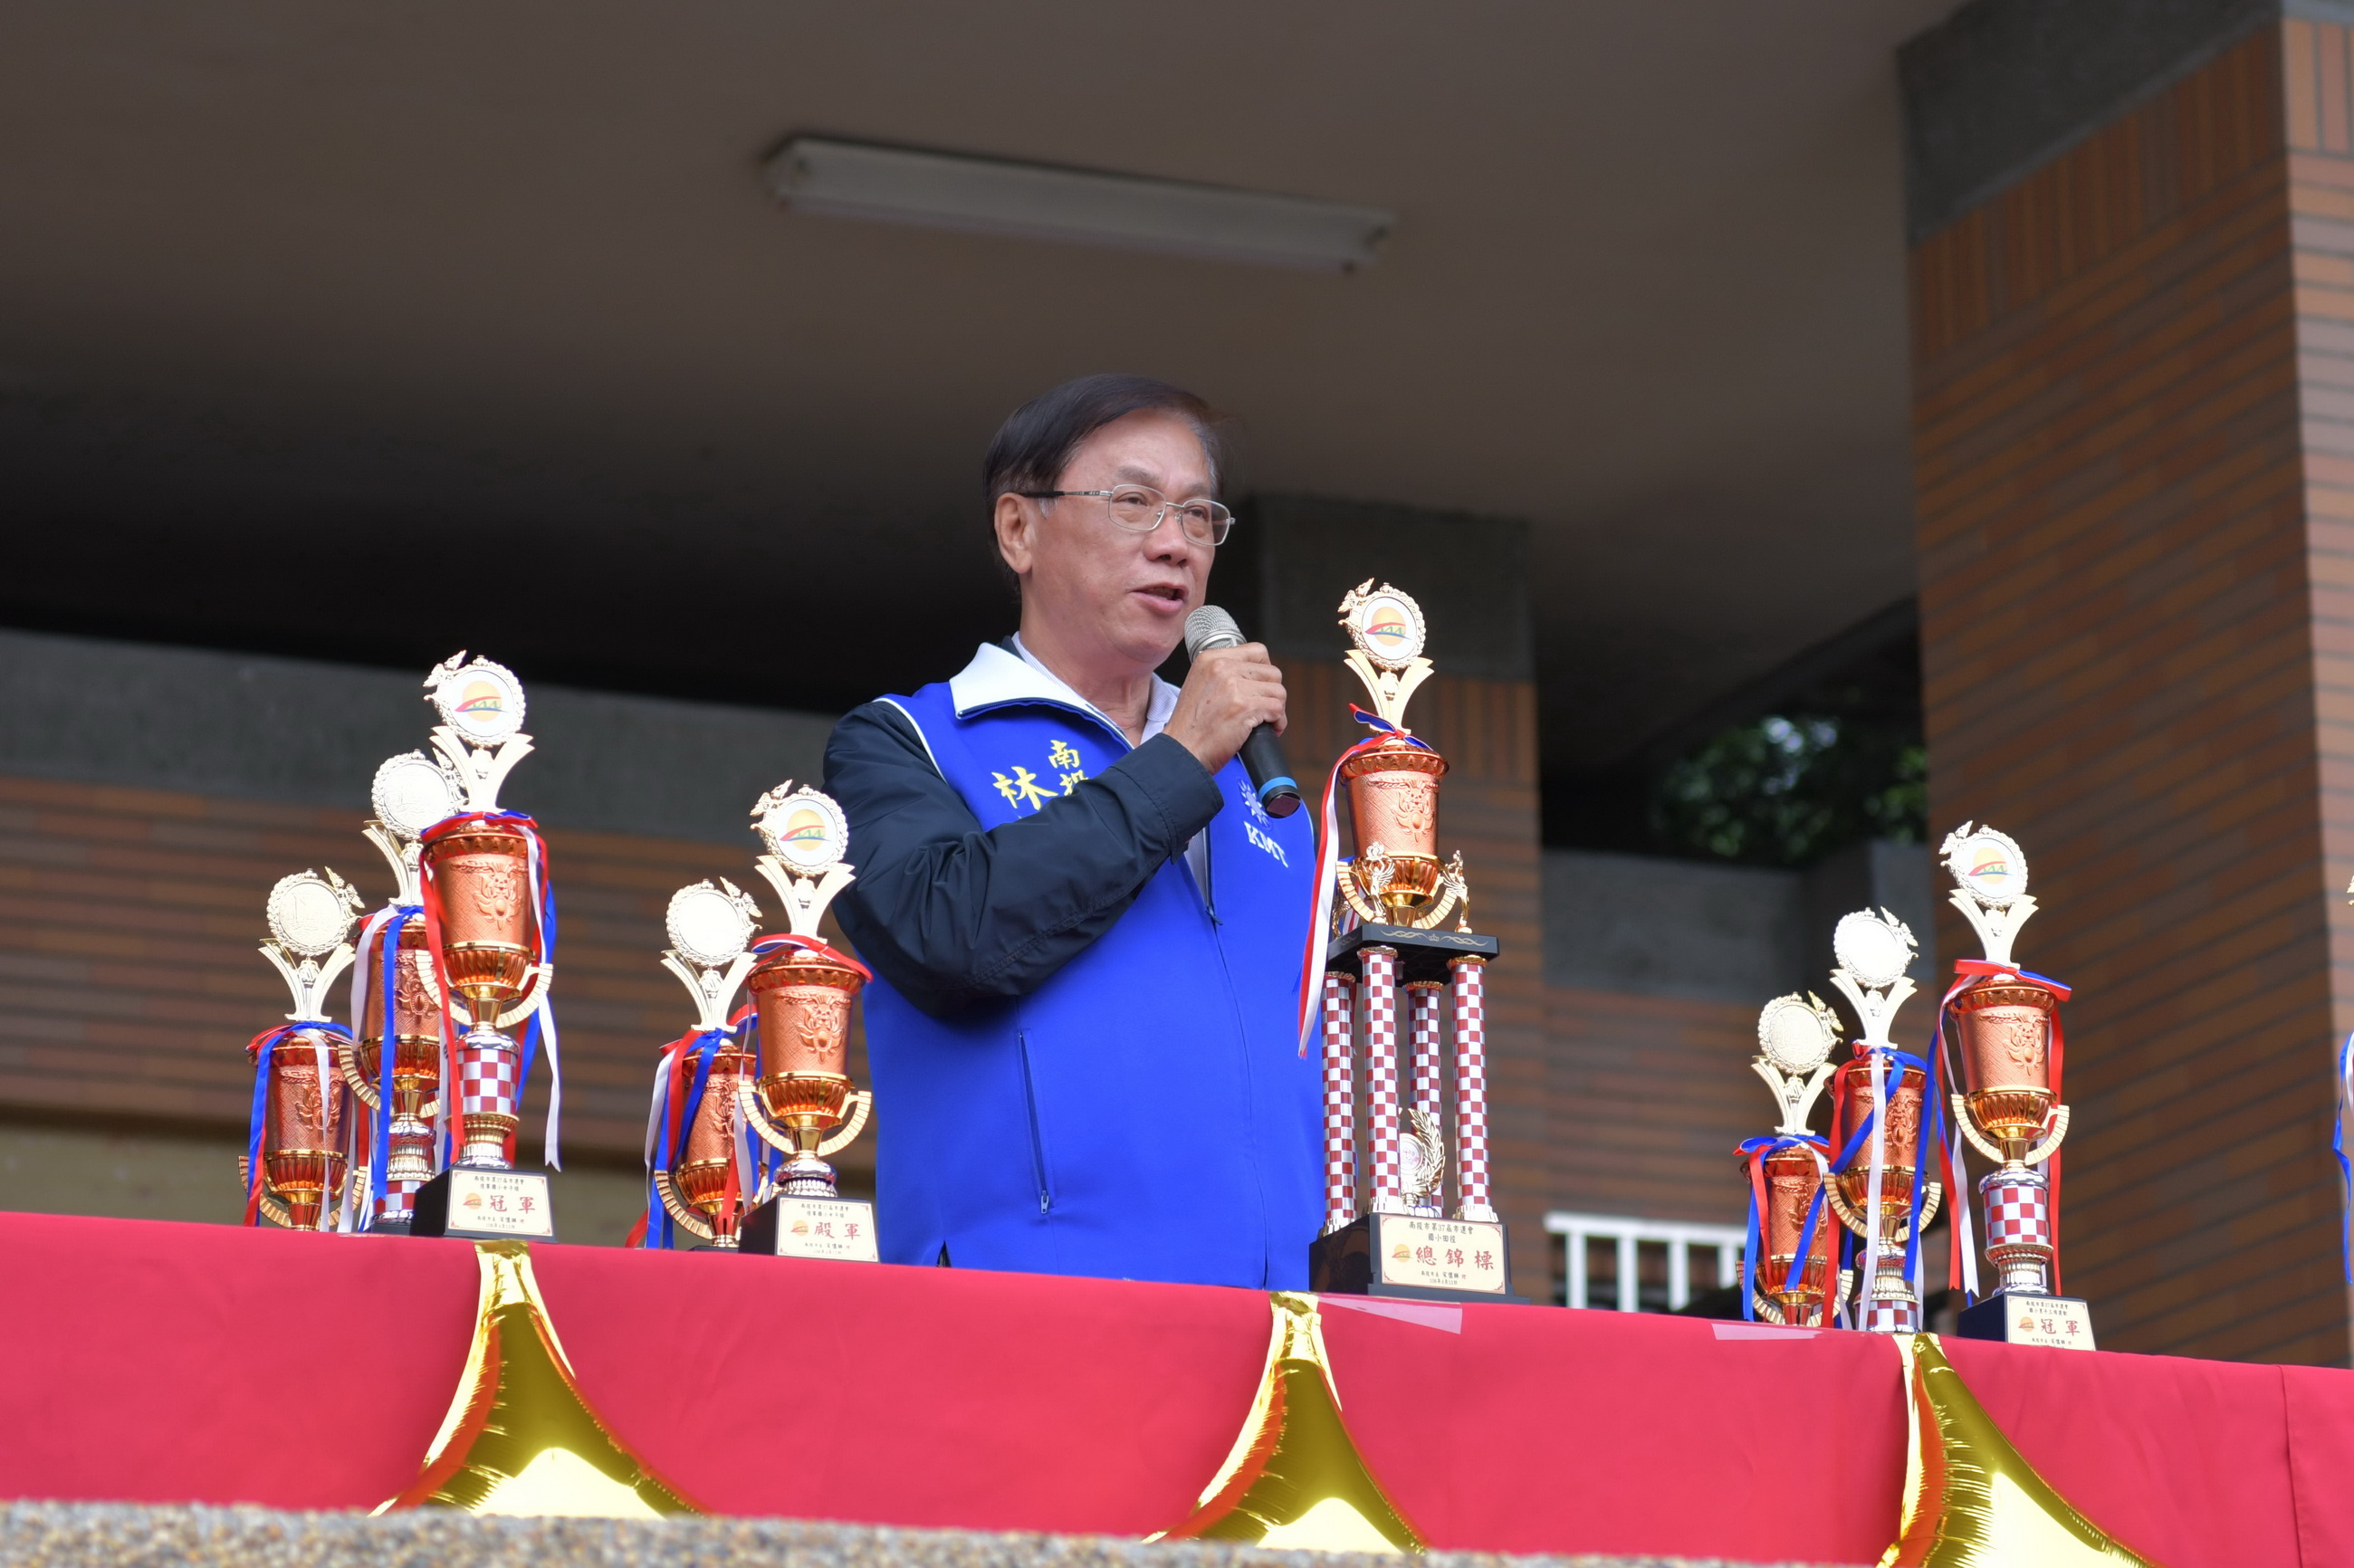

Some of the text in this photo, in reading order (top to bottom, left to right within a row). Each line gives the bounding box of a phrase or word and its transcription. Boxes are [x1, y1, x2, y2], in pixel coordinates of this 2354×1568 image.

[991, 766, 1058, 810] 林
[1244, 821, 1289, 868] KMT
[490, 1195, 535, 1214] 冠軍
[814, 1221, 860, 1240] 殿軍
[1409, 1221, 1473, 1234] 南投市第37屆市運會
[1428, 1233, 1456, 1243] 國小田徑
[1416, 1246, 1493, 1270] 總錦標
[2041, 1318, 2080, 1336] 冠軍
